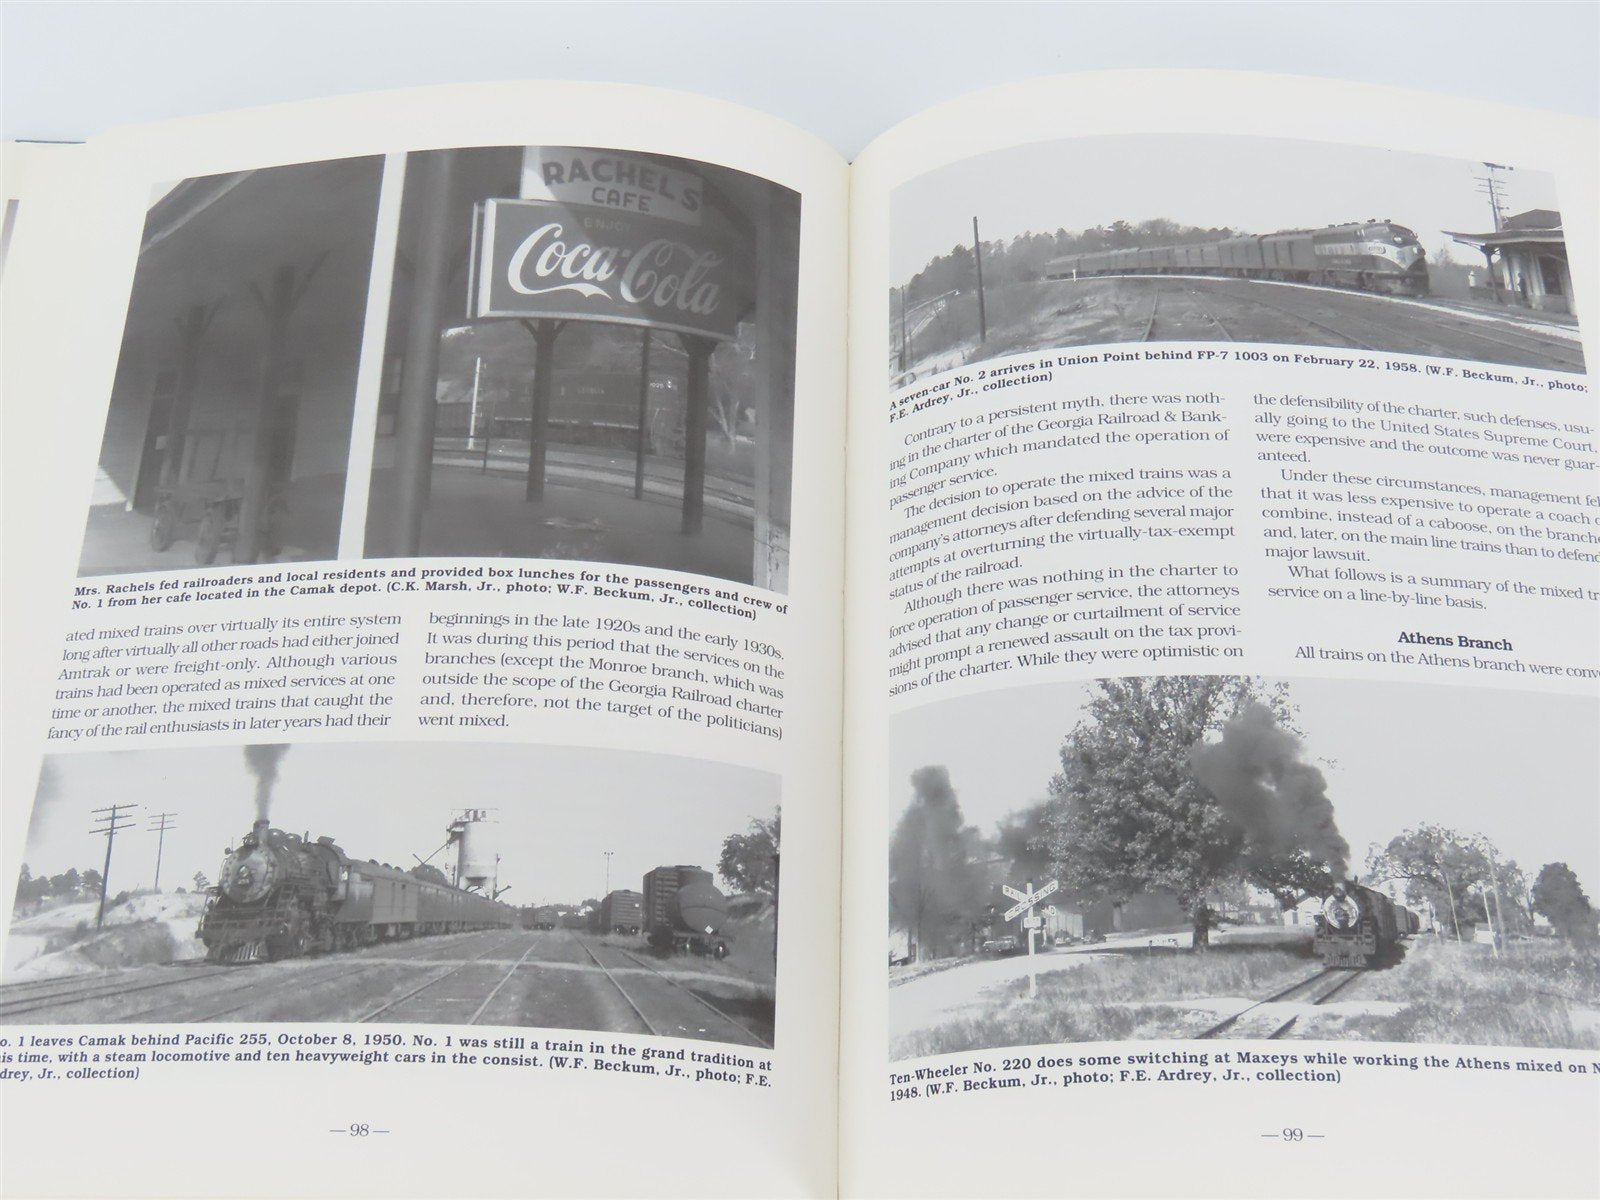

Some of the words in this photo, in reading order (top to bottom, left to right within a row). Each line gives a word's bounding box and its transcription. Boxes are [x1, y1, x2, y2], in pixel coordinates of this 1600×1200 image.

[591, 186, 653, 212] CAFE
[583, 216, 633, 233] ENJOY
[507, 222, 725, 316] Coca-Cola
[889, 401, 897, 411] A
[899, 381, 951, 406] seven-car
[954, 375, 974, 386] No.
[978, 370, 986, 380] 2
[990, 363, 1035, 377] arrives
[1039, 359, 1053, 369] in
[1057, 355, 1099, 367] Union
[1103, 352, 1141, 362] Point
[1144, 350, 1193, 360] behind
[1197, 350, 1230, 360] FP-7
[1234, 351, 1268, 361] 1003
[1272, 354, 1290, 363] on
[1294, 354, 1354, 369] February
[1358, 358, 1380, 370] 22,
[1385, 361, 1421, 373] 1958.
[1425, 364, 1458, 377] (W.F.
[1462, 369, 1518, 385] Beckum,
[1521, 376, 1544, 388] Jr.,
[1547, 380, 1588, 393] photo;
[889, 408, 909, 424] F.E.
[912, 392, 953, 414] Ardrey,
[957, 388, 978, 399] Jr.,
[982, 371, 1053, 392] collection)
[889, 556, 941, 581] attempts
[943, 550, 957, 563] at
[960, 535, 1046, 559] overturning
[1049, 531, 1074, 544] the
[1078, 526, 1235, 541] virtually-tax-exempt
[71, 600, 91, 610] No.
[97, 599, 103, 608] 1
[107, 597, 137, 607] from
[141, 595, 163, 605] her
[165, 592, 192, 603] cafe
[195, 588, 243, 601] located
[246, 588, 259, 598] in
[264, 586, 286, 597] the
[290, 584, 335, 595] Camak
[339, 583, 381, 595] depot.
[386, 581, 420, 593] (C.K.
[425, 580, 472, 592] Marsh,
[476, 581, 501, 592] Jr.,
[505, 582, 552, 594] photo;
[556, 583, 588, 595] W.F.
[593, 586, 654, 603] Beckum,
[659, 593, 683, 607] Jr.,
[688, 599, 756, 621] collection)
[74, 586, 101, 597] Mrs.
[105, 581, 155, 594] Rachels
[159, 579, 179, 590] fed
[183, 575, 253, 589] railroaders
[257, 573, 282, 584] and
[286, 570, 318, 582] local
[322, 569, 386, 580] residents
[390, 567, 416, 578] and
[420, 567, 483, 580] provided
[488, 567, 514, 578] box
[518, 568, 575, 580] lunches
[580, 570, 601, 582] for
[606, 573, 629, 585] the
[634, 578, 710, 596] passengers
[714, 590, 739, 602] and
[743, 596, 772, 610] crew
[775, 604, 789, 615] of
[904, 587, 962, 614] Although
[967, 581, 1004, 597] there
[1008, 577, 1038, 588] was
[1042, 569, 1104, 584] nothing
[1108, 567, 1124, 578] in
[1129, 565, 1155, 577] the
[1159, 564, 1218, 576] charter
[1223, 565, 1238, 576] to
[1268, 586, 1319, 598] service
[1323, 590, 1343, 599] on
[1347, 591, 1357, 600] a
[1360, 588, 1442, 607] line-by-line
[1445, 594, 1487, 610] basis.
[65, 628, 95, 642] ated
[98, 625, 140, 640] mixed
[144, 624, 184, 636] trains
[187, 623, 218, 634] over
[221, 617, 279, 633] virtually
[282, 617, 300, 628] its
[303, 615, 346, 627] entire
[349, 614, 401, 629] system
[1397, 631, 1454, 647] Athens
[1457, 635, 1514, 651] Branch
[425, 652, 496, 665] branches
[501, 652, 554, 670] (except
[559, 655, 584, 669] the
[589, 657, 647, 674] Monroe
[652, 663, 708, 685] branch,
[713, 674, 755, 692] which
[758, 685, 784, 699] was
[418, 714, 455, 726] went
[458, 714, 509, 727] mixed.
[1007, 883, 1057, 920] CROSSING
[0, 1038, 11, 1047] o.
[18, 1036, 24, 1047] 1
[30, 1035, 73, 1047] leaves
[78, 1034, 126, 1046] Camak
[131, 1034, 180, 1046] behind
[184, 1033, 234, 1045] Pacific
[239, 1033, 271, 1046] 255,
[277, 1033, 338, 1045] October
[342, 1033, 356, 1047] 8,
[364, 1034, 406, 1046] 1950.
[412, 1035, 437, 1047] No.
[445, 1035, 452, 1047] 1
[459, 1038, 488, 1048] was
[493, 1037, 525, 1050] still
[530, 1041, 539, 1050] a
[545, 1040, 584, 1053] train
[589, 1041, 605, 1054] in
[611, 1043, 636, 1056] the
[641, 1047, 685, 1061] grand
[690, 1051, 754, 1069] tradition
[759, 1060, 772, 1071] at
[889, 1064, 969, 1085] Ten-Wheeler
[973, 1061, 996, 1074] No.
[1002, 1057, 1032, 1071] 220
[1037, 1056, 1073, 1068] does
[1079, 1056, 1121, 1066] some
[1127, 1051, 1209, 1067] switching
[1214, 1052, 1231, 1064] at
[1236, 1051, 1298, 1067] Maxeys
[1303, 1052, 1347, 1065] while
[1352, 1054, 1419, 1071] working
[1423, 1055, 1450, 1068] the
[1455, 1057, 1511, 1070] Athens
[1515, 1059, 1563, 1073] mixed
[1568, 1064, 1587, 1074] on
[0, 1068, 33, 1082] drey,
[37, 1068, 61, 1080] Jr.,
[66, 1066, 140, 1080] collection)
[890, 1086, 921, 1102] 1948.
[926, 1081, 958, 1098] (W.F.
[963, 1077, 1026, 1092] Beckum,
[1030, 1074, 1057, 1086] Jr.,
[1063, 1071, 1114, 1087] photo;
[1119, 1069, 1151, 1082] F.E.
[1157, 1069, 1217, 1084] Ardrey,
[1222, 1069, 1250, 1082] Jr.,
[1256, 1069, 1341, 1084] collection)
